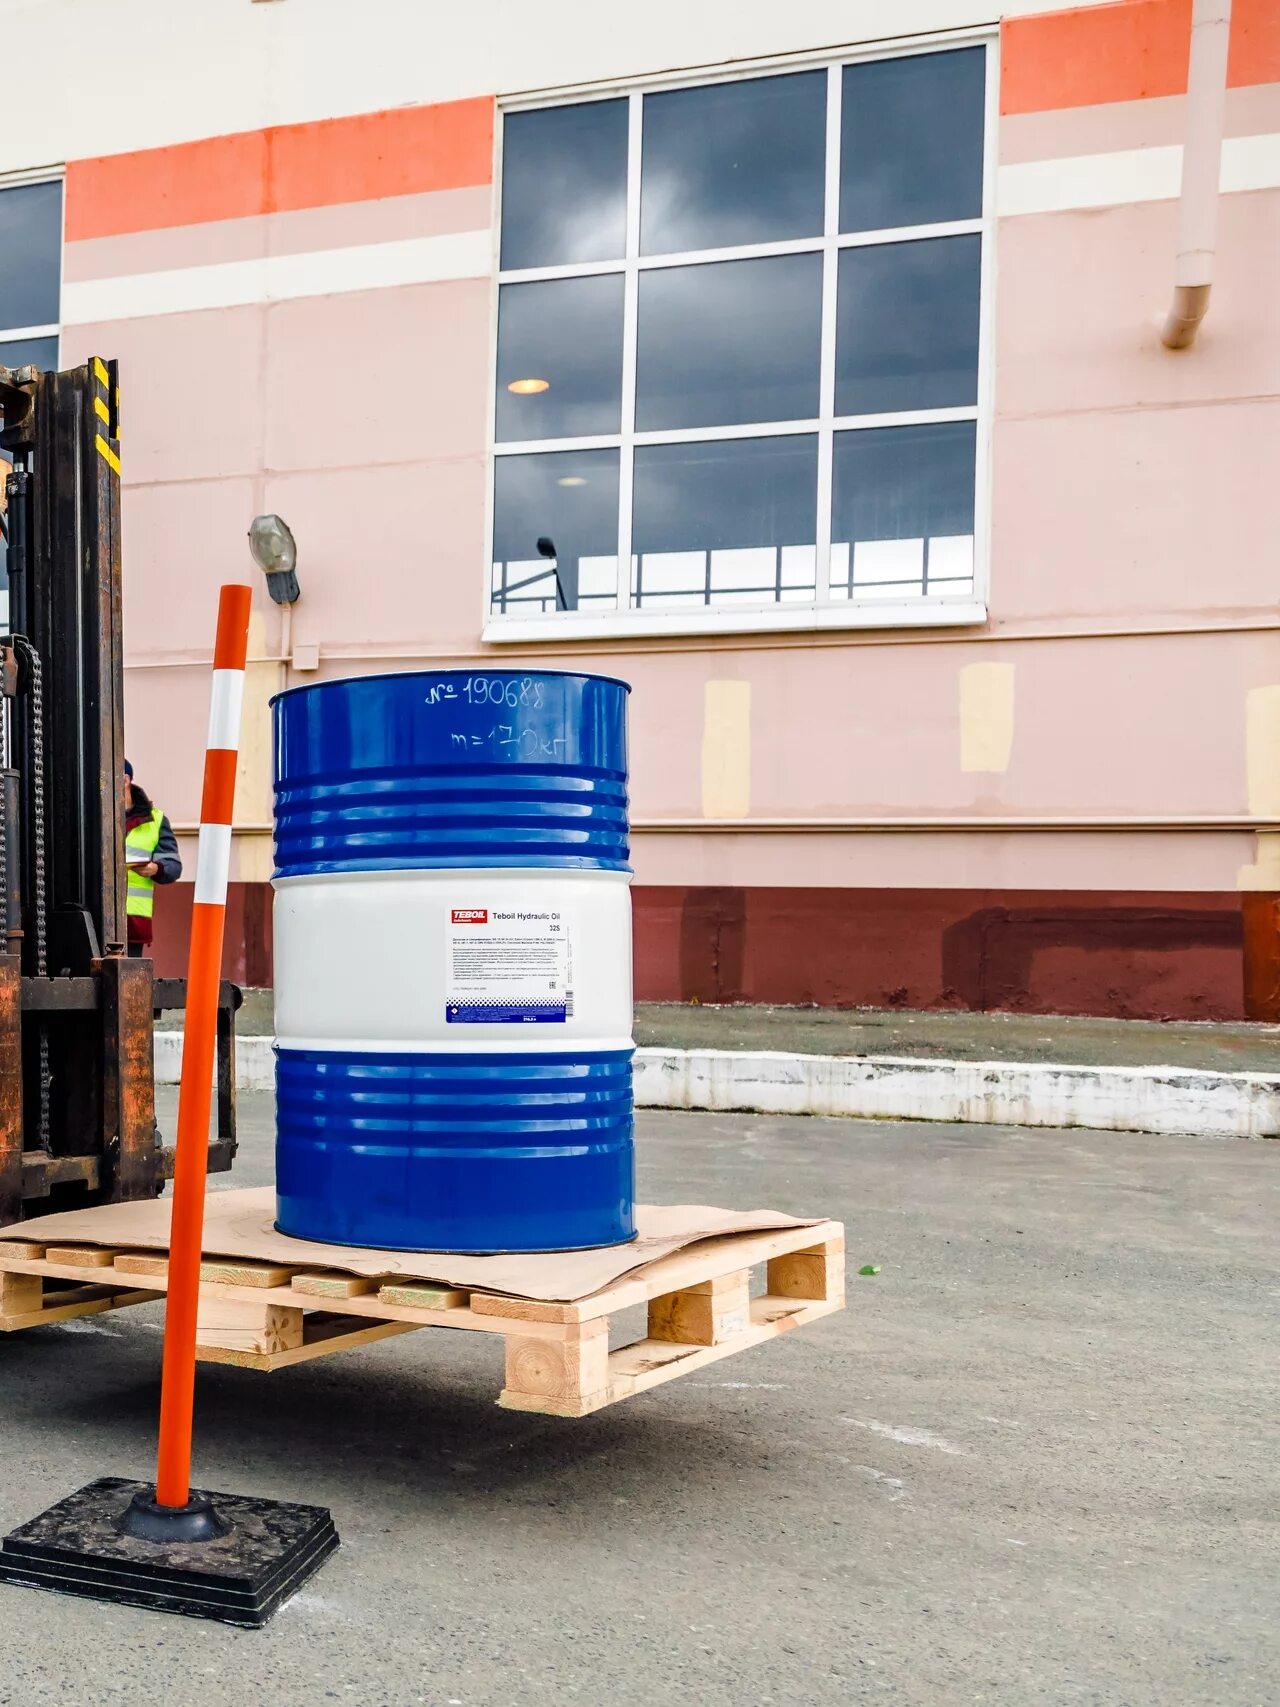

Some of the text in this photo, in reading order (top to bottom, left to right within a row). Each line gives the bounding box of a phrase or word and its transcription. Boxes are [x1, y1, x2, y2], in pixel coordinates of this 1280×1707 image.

[463, 677, 545, 709] 190688
[453, 911, 485, 919] TEBOIL
[517, 913, 549, 921] Hydraulic
